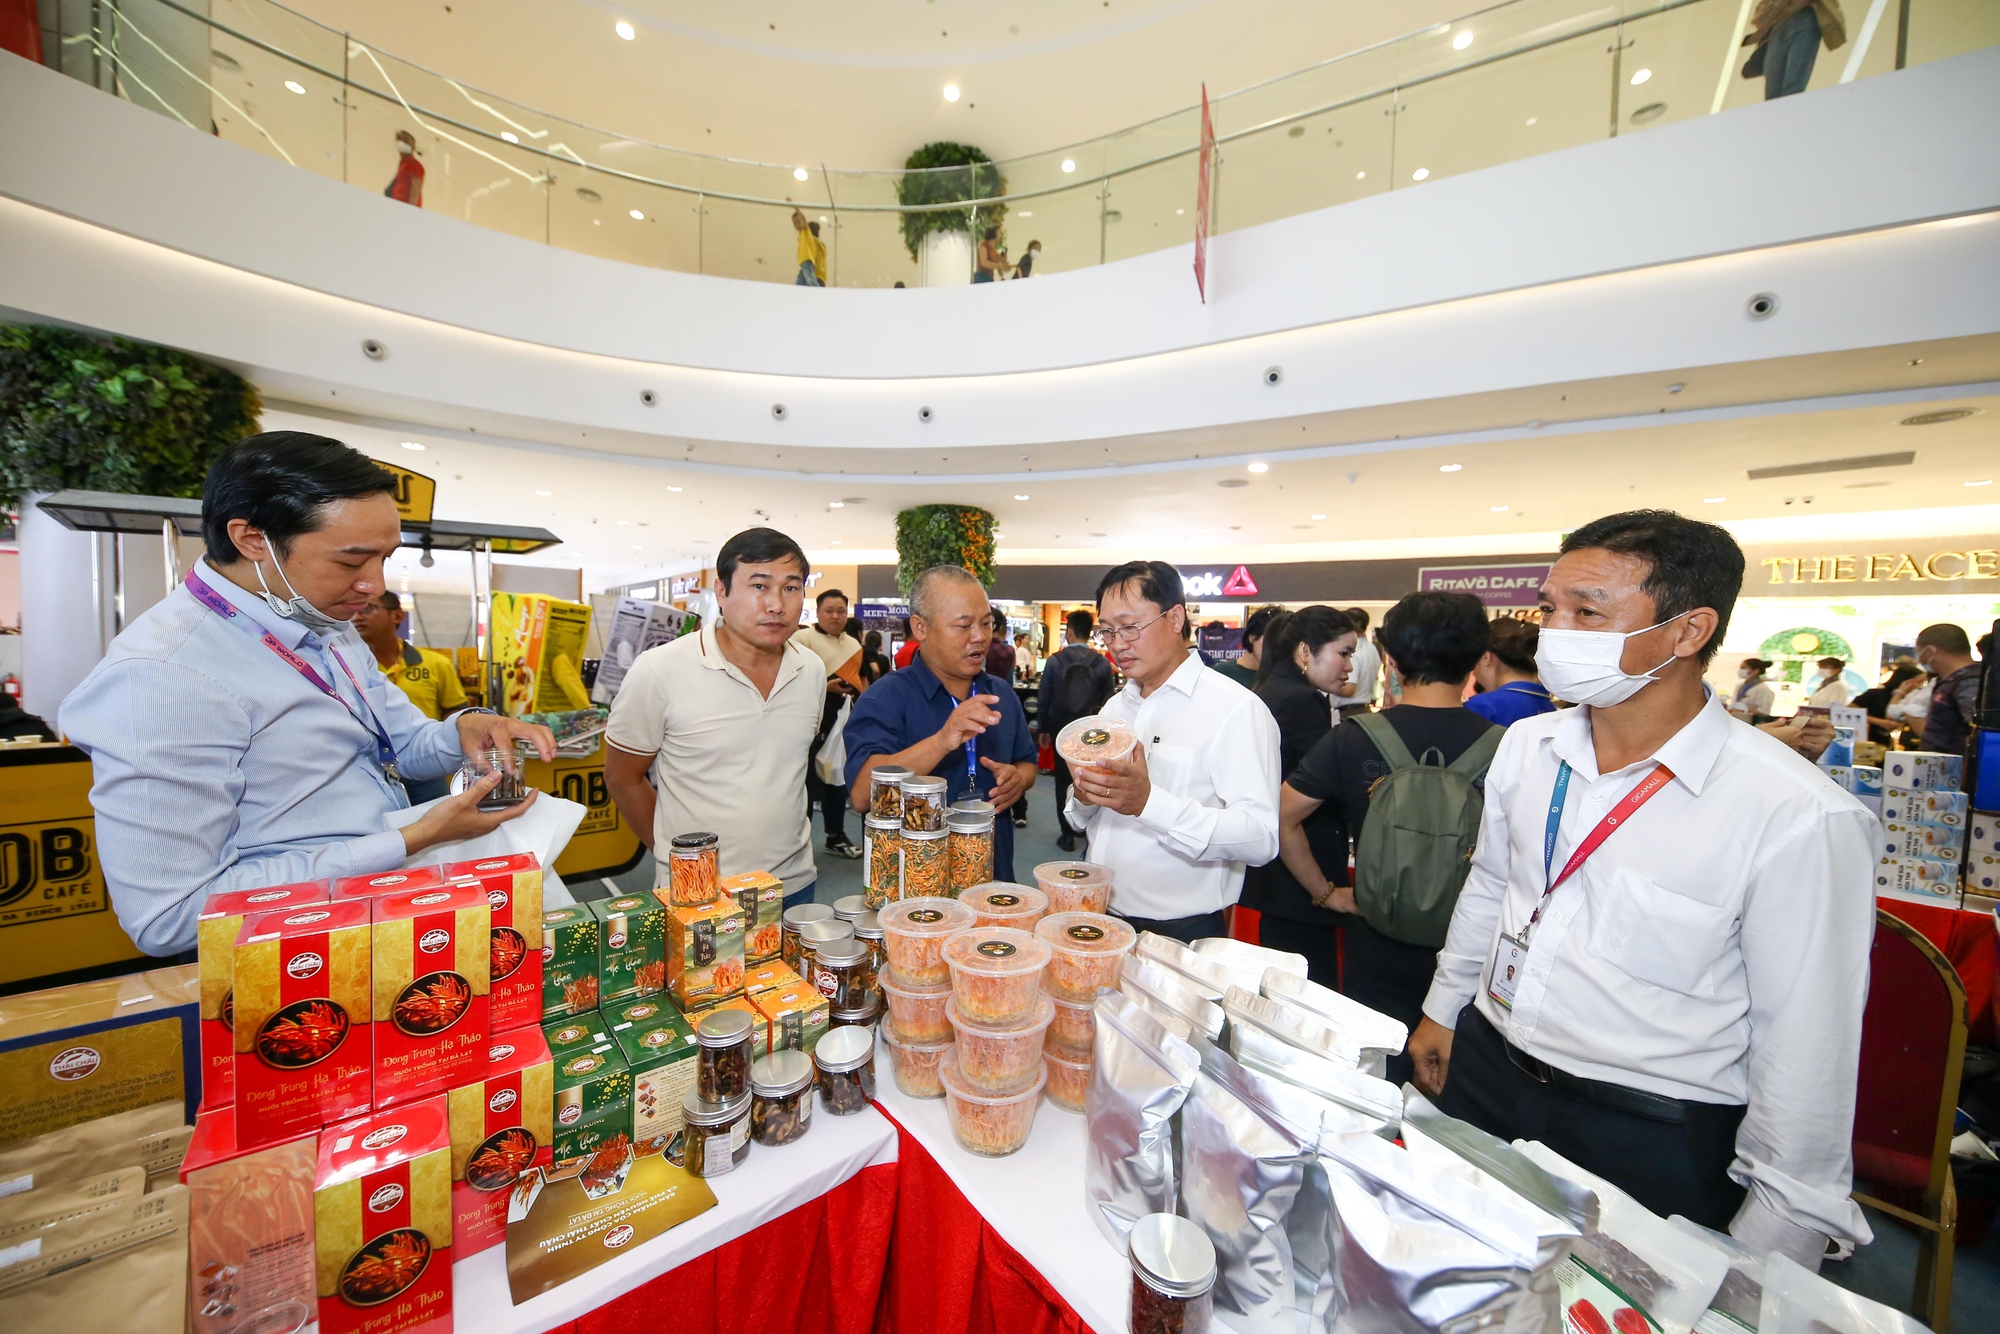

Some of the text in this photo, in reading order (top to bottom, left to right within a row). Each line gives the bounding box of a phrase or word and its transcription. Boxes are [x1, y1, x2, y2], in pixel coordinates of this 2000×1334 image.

[1761, 549, 2000, 583] THE FACE
[197, 587, 236, 617] DP WORLD
[265, 636, 303, 667] DP WORLD
[1203, 650, 1225, 659] STANT
[1631, 778, 1660, 803] GIGAMALL
[1564, 851, 1585, 874] GIGAMALL
[44, 880, 91, 899] CAFÉ
[53, 1056, 99, 1073] THÁI CHÂU
[212, 1055, 234, 1067] Đôn
[539, 1185, 678, 1248] CÀ PHÊ NGUYÊN CHẤT THÁI CHÂU
[547, 1192, 676, 1254] SẢN PHẨM CỦA CÔNG TY TNHH
